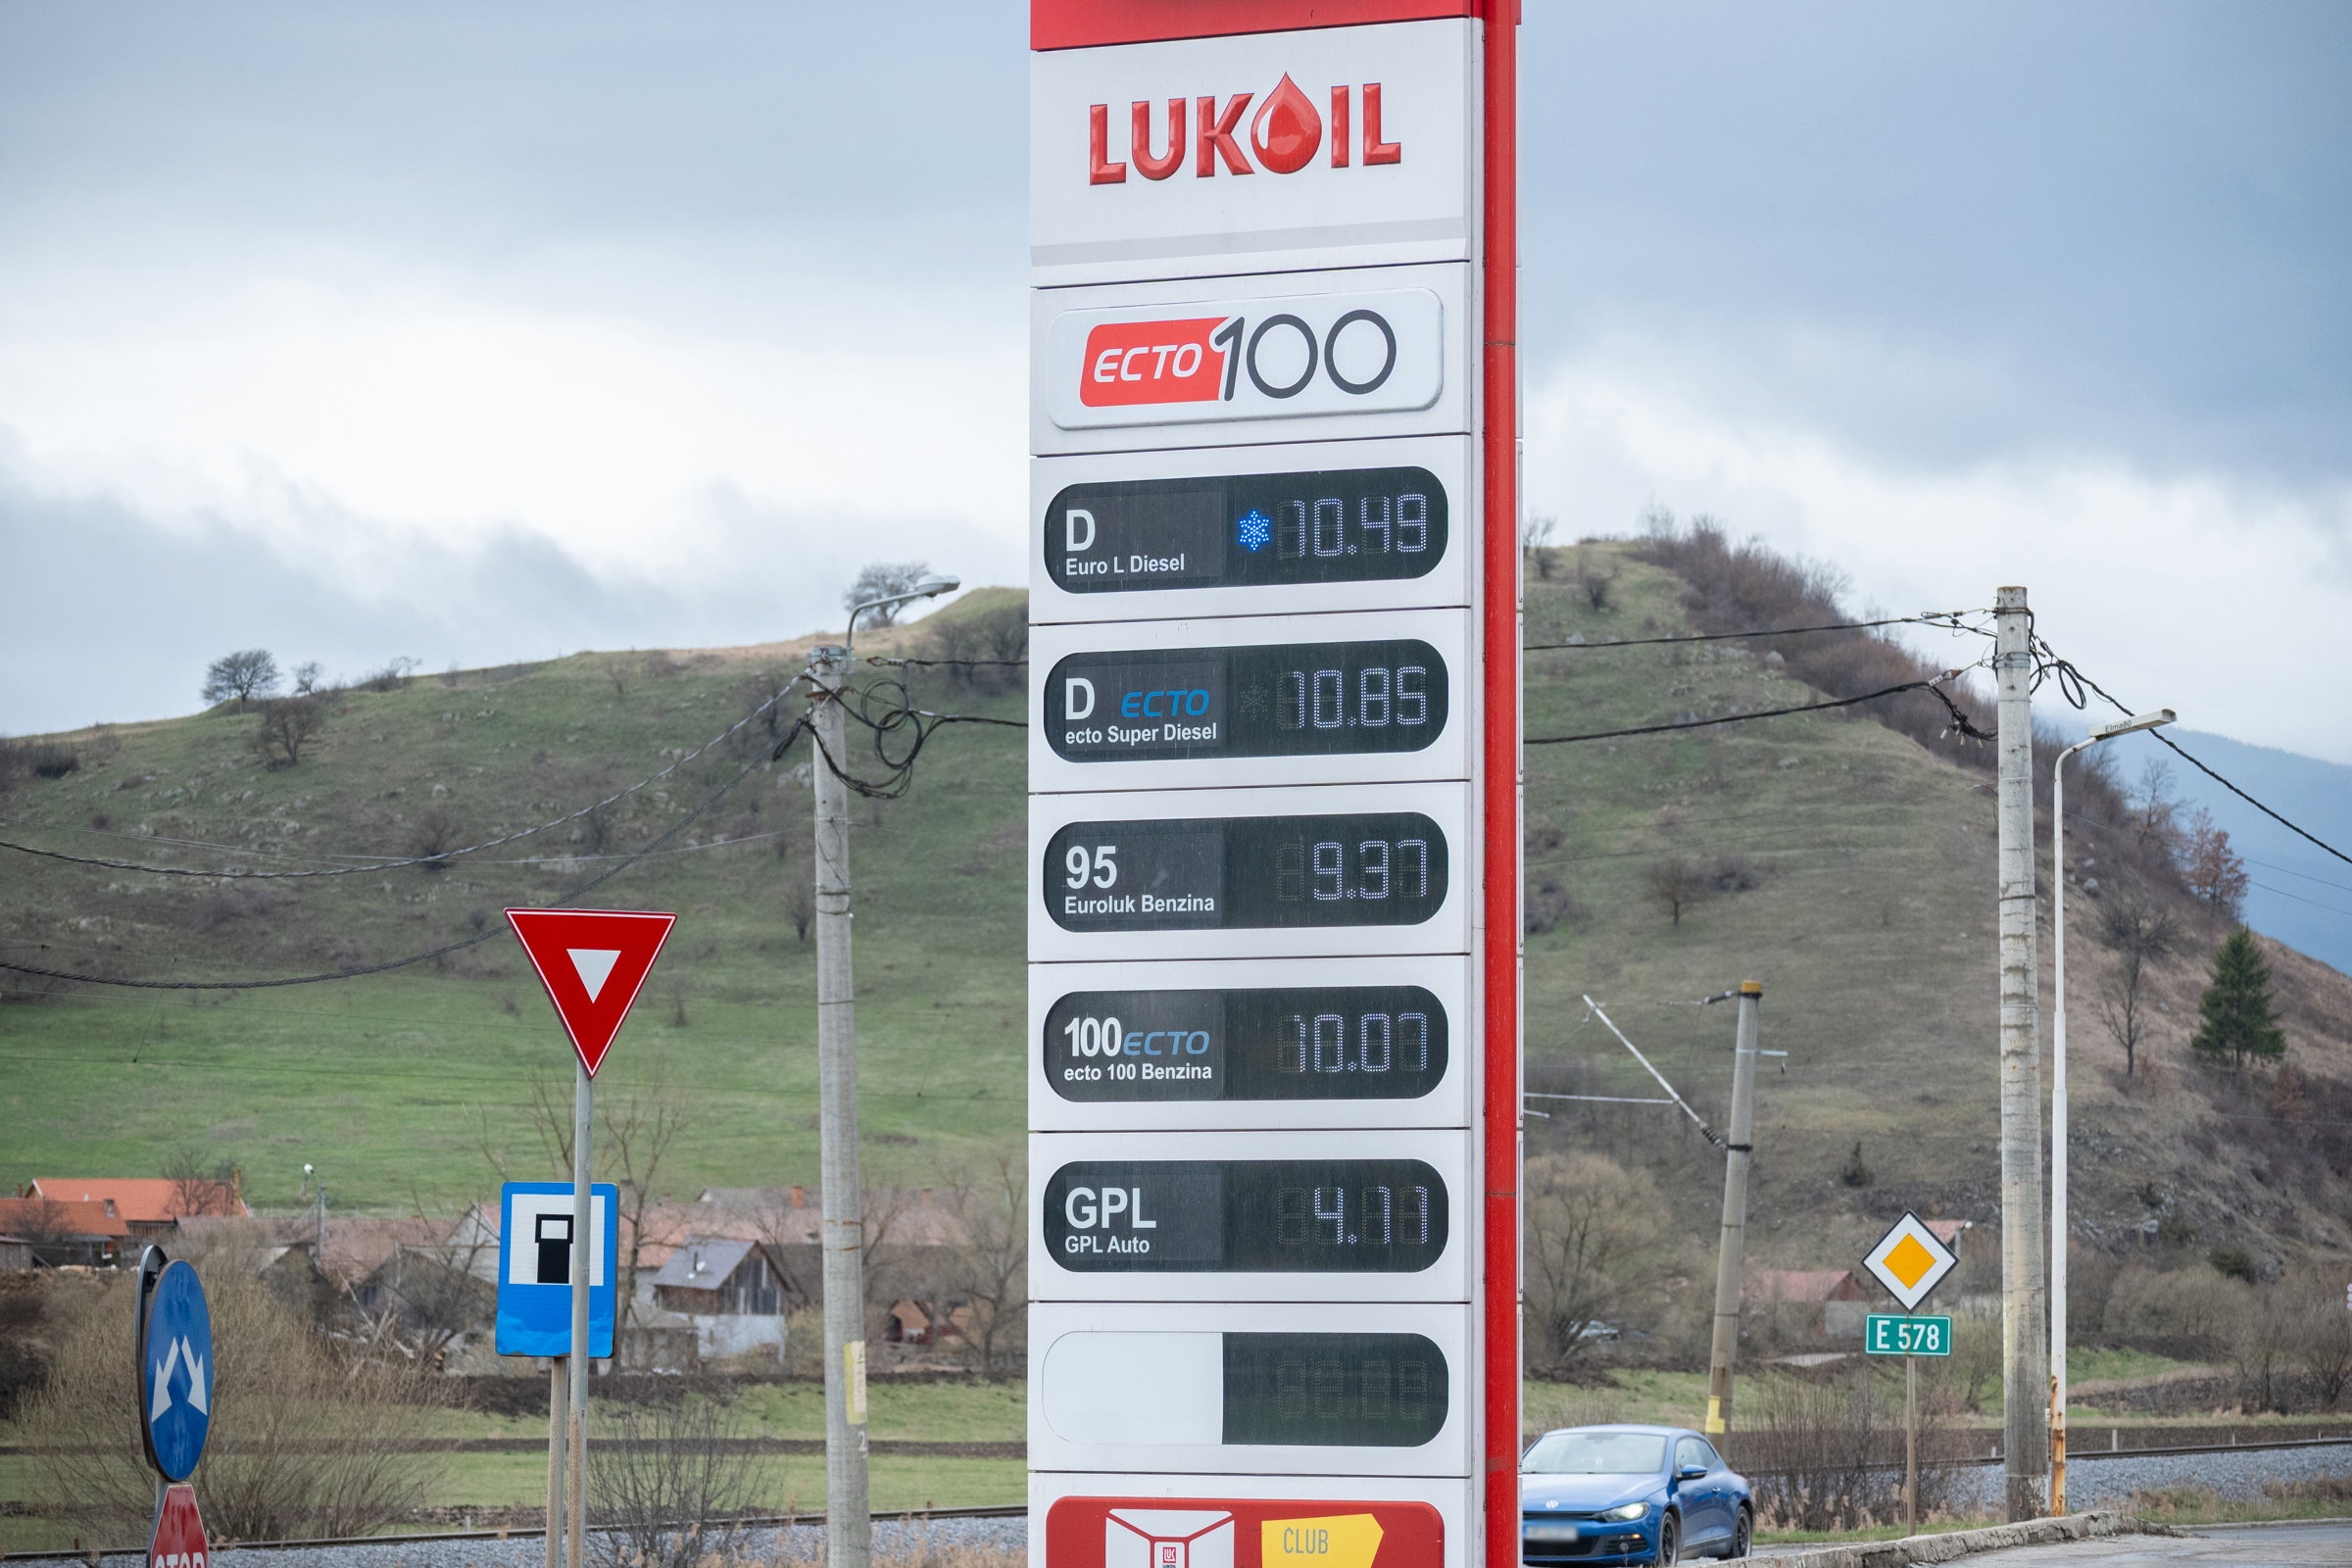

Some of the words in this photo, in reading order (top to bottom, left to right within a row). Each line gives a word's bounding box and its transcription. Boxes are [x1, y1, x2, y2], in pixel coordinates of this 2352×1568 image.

[1090, 72, 1401, 186] LUKOIL
[1093, 343, 1202, 382] ECTO
[1214, 309, 1396, 402] 100
[1065, 509, 1096, 552] D
[1294, 494, 1427, 558] 10.49
[1066, 558, 1108, 576] Euro
[1113, 557, 1124, 573] L
[1130, 553, 1185, 573] Diesel
[1065, 677, 1096, 720] D
[1120, 689, 1210, 717] ECTO
[1294, 666, 1427, 728] 10.85
[1065, 727, 1102, 745] ecto
[1107, 725, 1158, 747] Super
[1163, 722, 1217, 741] Diesel
[1065, 845, 1117, 890] 95
[1313, 840, 1427, 900] 9.37
[1064, 895, 1136, 914] Euroluk
[1141, 894, 1214, 912] Benzina
[1064, 1016, 1122, 1057] 100
[1122, 1031, 1210, 1056] ECTO
[1294, 1012, 1427, 1072] 10.07
[1064, 1064, 1102, 1081] ecto
[1106, 1063, 1137, 1081] 100
[1142, 1062, 1212, 1080] Benzina
[1065, 1187, 1156, 1229] GPL
[1314, 1186, 1427, 1244] 4.11
[1064, 1236, 1103, 1253] GPL
[1106, 1236, 1151, 1253] Auto
[1877, 1320, 1890, 1348] E
[1898, 1324, 1939, 1350] 578
[1284, 1528, 1329, 1554] CLUB
